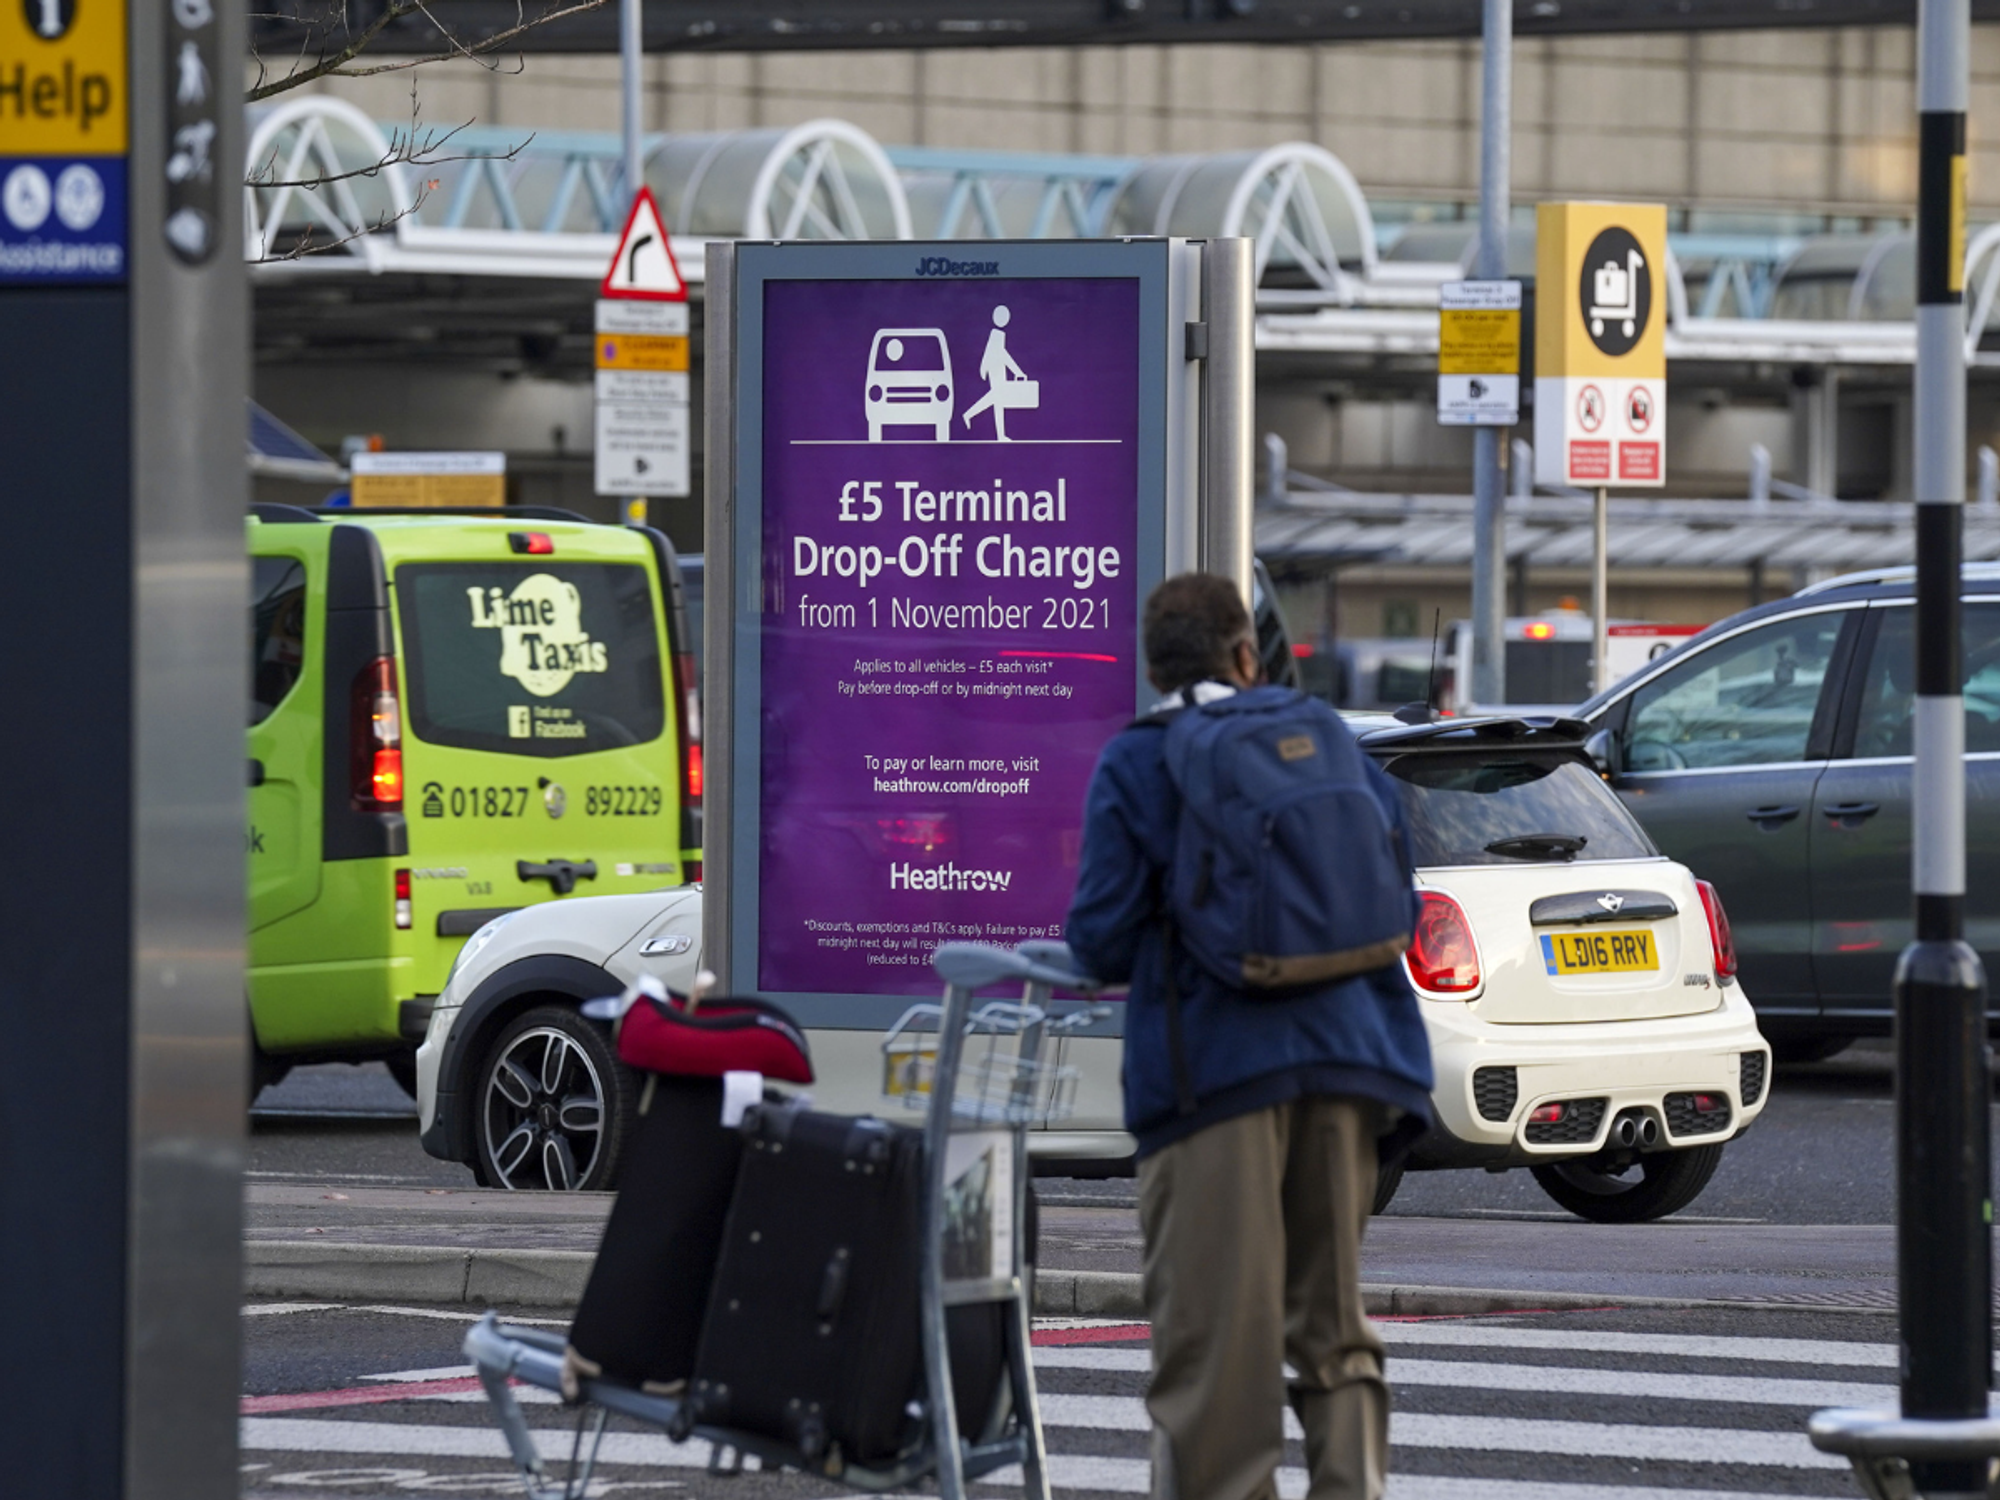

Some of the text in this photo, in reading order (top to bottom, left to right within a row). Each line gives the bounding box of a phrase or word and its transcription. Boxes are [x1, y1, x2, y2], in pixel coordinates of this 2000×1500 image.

[0, 58, 112, 137] Help
[0, 237, 123, 274] ssistance
[915, 256, 1000, 276] JCDecaux
[839, 478, 1065, 521] £5 Terminal
[794, 533, 1120, 589] Drop-Off Charge
[466, 585, 555, 628] Lime
[799, 594, 1108, 628] from 1 November 2021
[519, 630, 609, 674] Taxis
[854, 659, 891, 675] Applies
[894, 661, 906, 672] to
[909, 659, 921, 672] all
[924, 660, 966, 672] vehicles
[980, 660, 993, 672] £5
[997, 660, 1022, 673] each
[839, 680, 1073, 699] Pay before drop-off or by midnight next day
[864, 755, 1039, 774] To pay or learn more, visit
[451, 786, 662, 818] 01827 892229
[874, 777, 1029, 797] heathrow.com/dropoff
[891, 862, 1011, 891] Heathrow
[818, 936, 857, 950] midnight
[860, 939, 880, 948] next
[882, 937, 899, 951] day
[902, 938, 917, 948] will
[857, 922, 909, 934] exemptions
[912, 922, 929, 933] and
[932, 922, 956, 934] T&Cs
[986, 923, 1015, 934] Failure
[1018, 925, 1027, 935] to
[1028, 927, 1047, 941] pay
[1049, 925, 1060, 936] £5
[867, 949, 907, 965] (reduced
[910, 955, 919, 965] to
[1560, 935, 1648, 968] LD16 RRY
